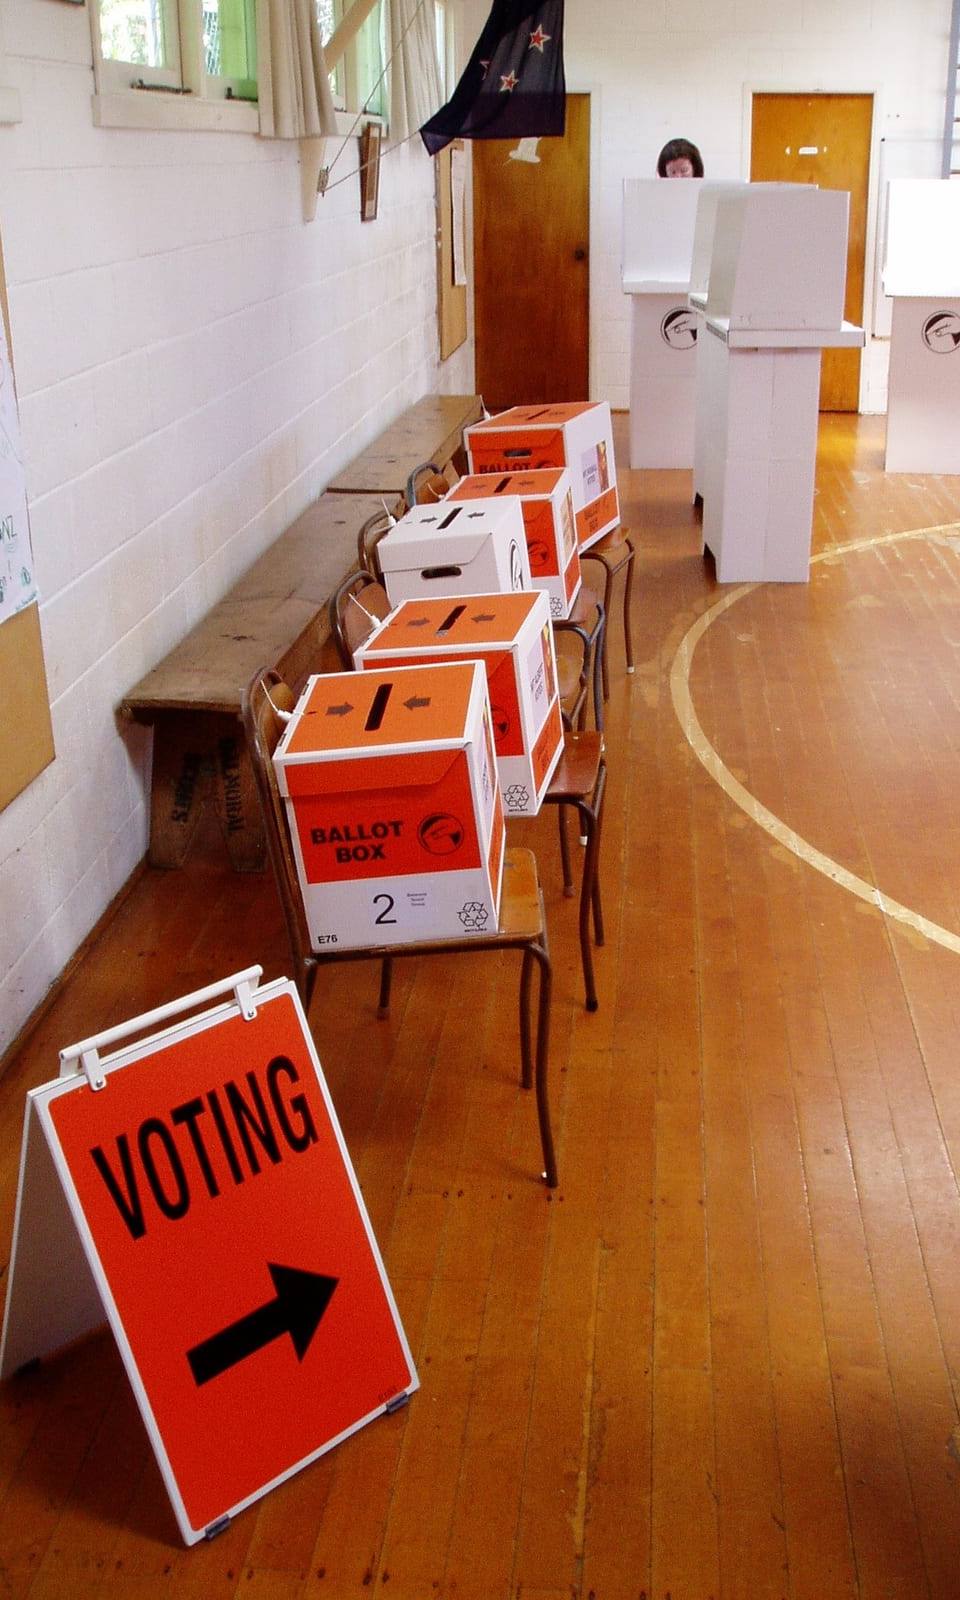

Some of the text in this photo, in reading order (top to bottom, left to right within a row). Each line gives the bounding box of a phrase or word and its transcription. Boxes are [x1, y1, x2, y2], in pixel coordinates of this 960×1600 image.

[311, 819, 404, 845] BALLOT
[336, 843, 386, 864] BOX
[373, 893, 397, 925] 2
[317, 933, 338, 945] E76
[90, 1055, 318, 1240] VOTING
